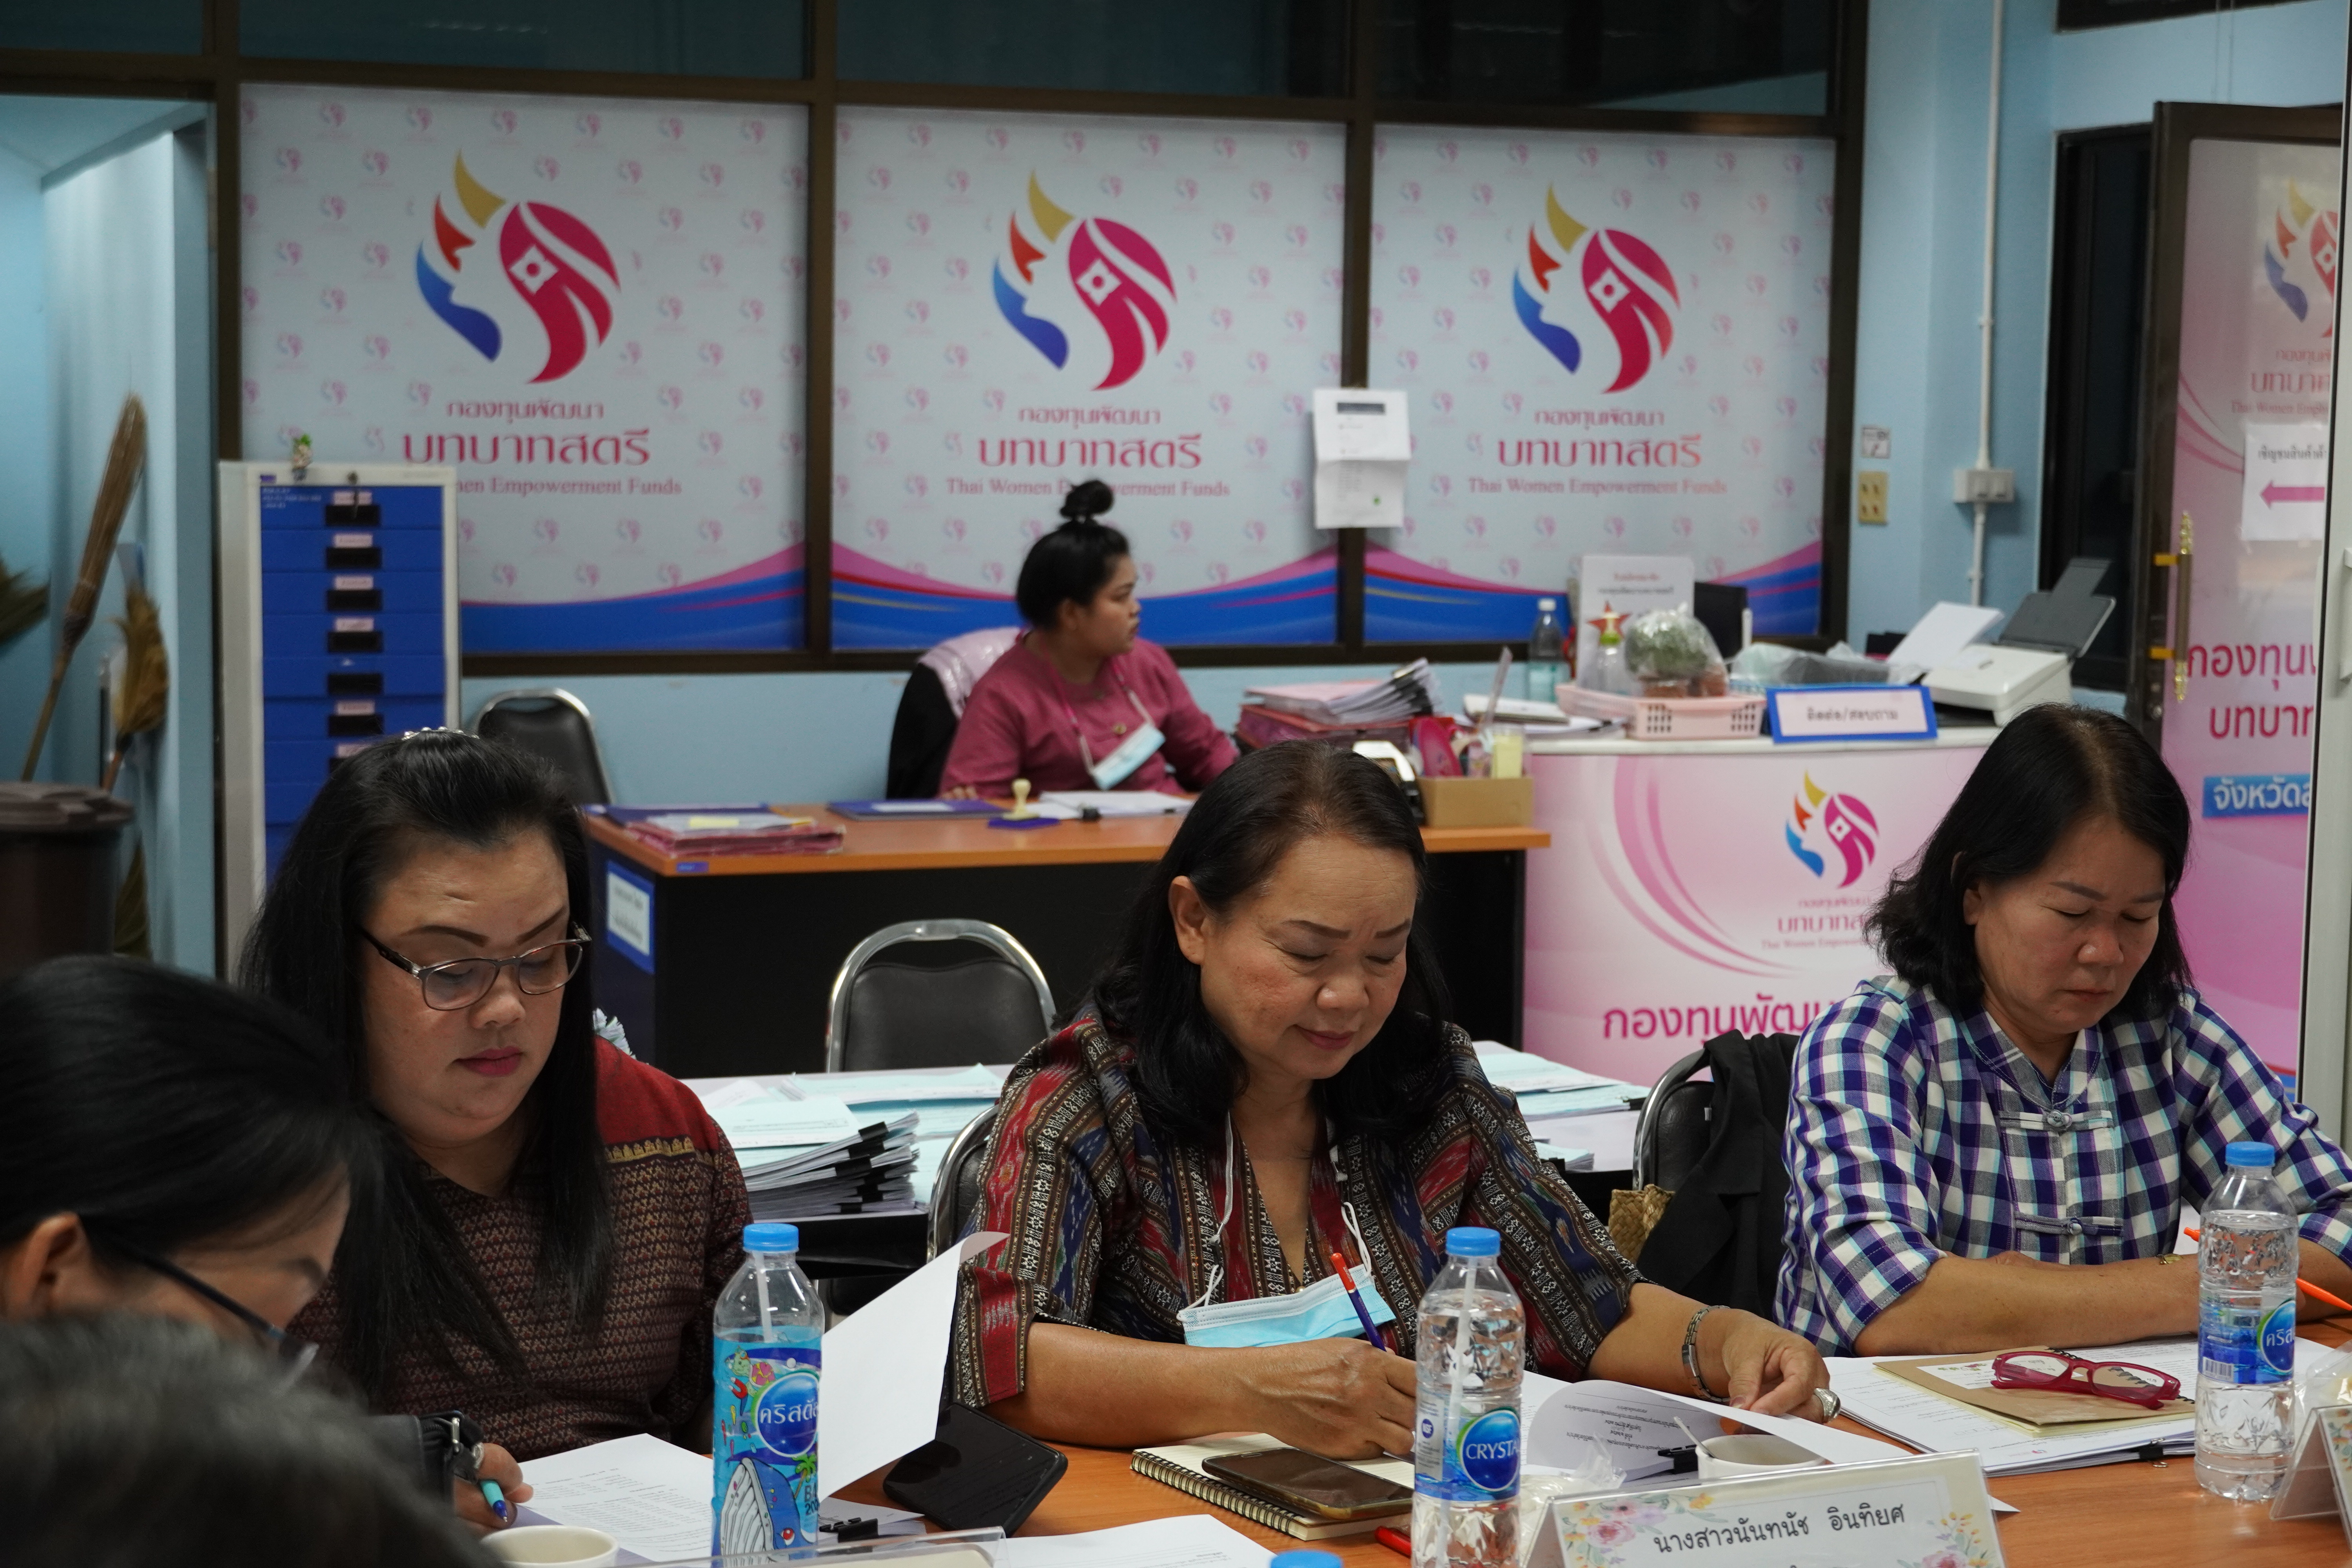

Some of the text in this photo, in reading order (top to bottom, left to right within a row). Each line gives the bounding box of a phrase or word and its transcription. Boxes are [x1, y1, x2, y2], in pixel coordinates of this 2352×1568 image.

[446, 399, 604, 424] กองทุนพัฒนา
[1019, 405, 1161, 430] กองทุนพัฒนา
[1534, 407, 1665, 432] กองทุนพัฒนา
[403, 428, 651, 466] บทบาทสตรี
[979, 432, 1202, 469] บทบาทสตรี
[1497, 432, 1702, 468] บทบาทสตรี
[491, 477, 622, 497] Empowerment
[628, 477, 682, 494] Funds
[947, 477, 983, 494] Thai
[989, 477, 1052, 495] Women
[1181, 481, 1230, 497] Funds
[1469, 475, 1502, 493] Thai
[1506, 478, 1564, 494] Women
[2188, 643, 2316, 691] กองทุน
[1778, 914, 1867, 934] บทบาทส
[1604, 992, 1835, 1045] กองทุนพัฒ
[1653, 1502, 1905, 1553] นางสาวนันทนัช อินทิยศ
